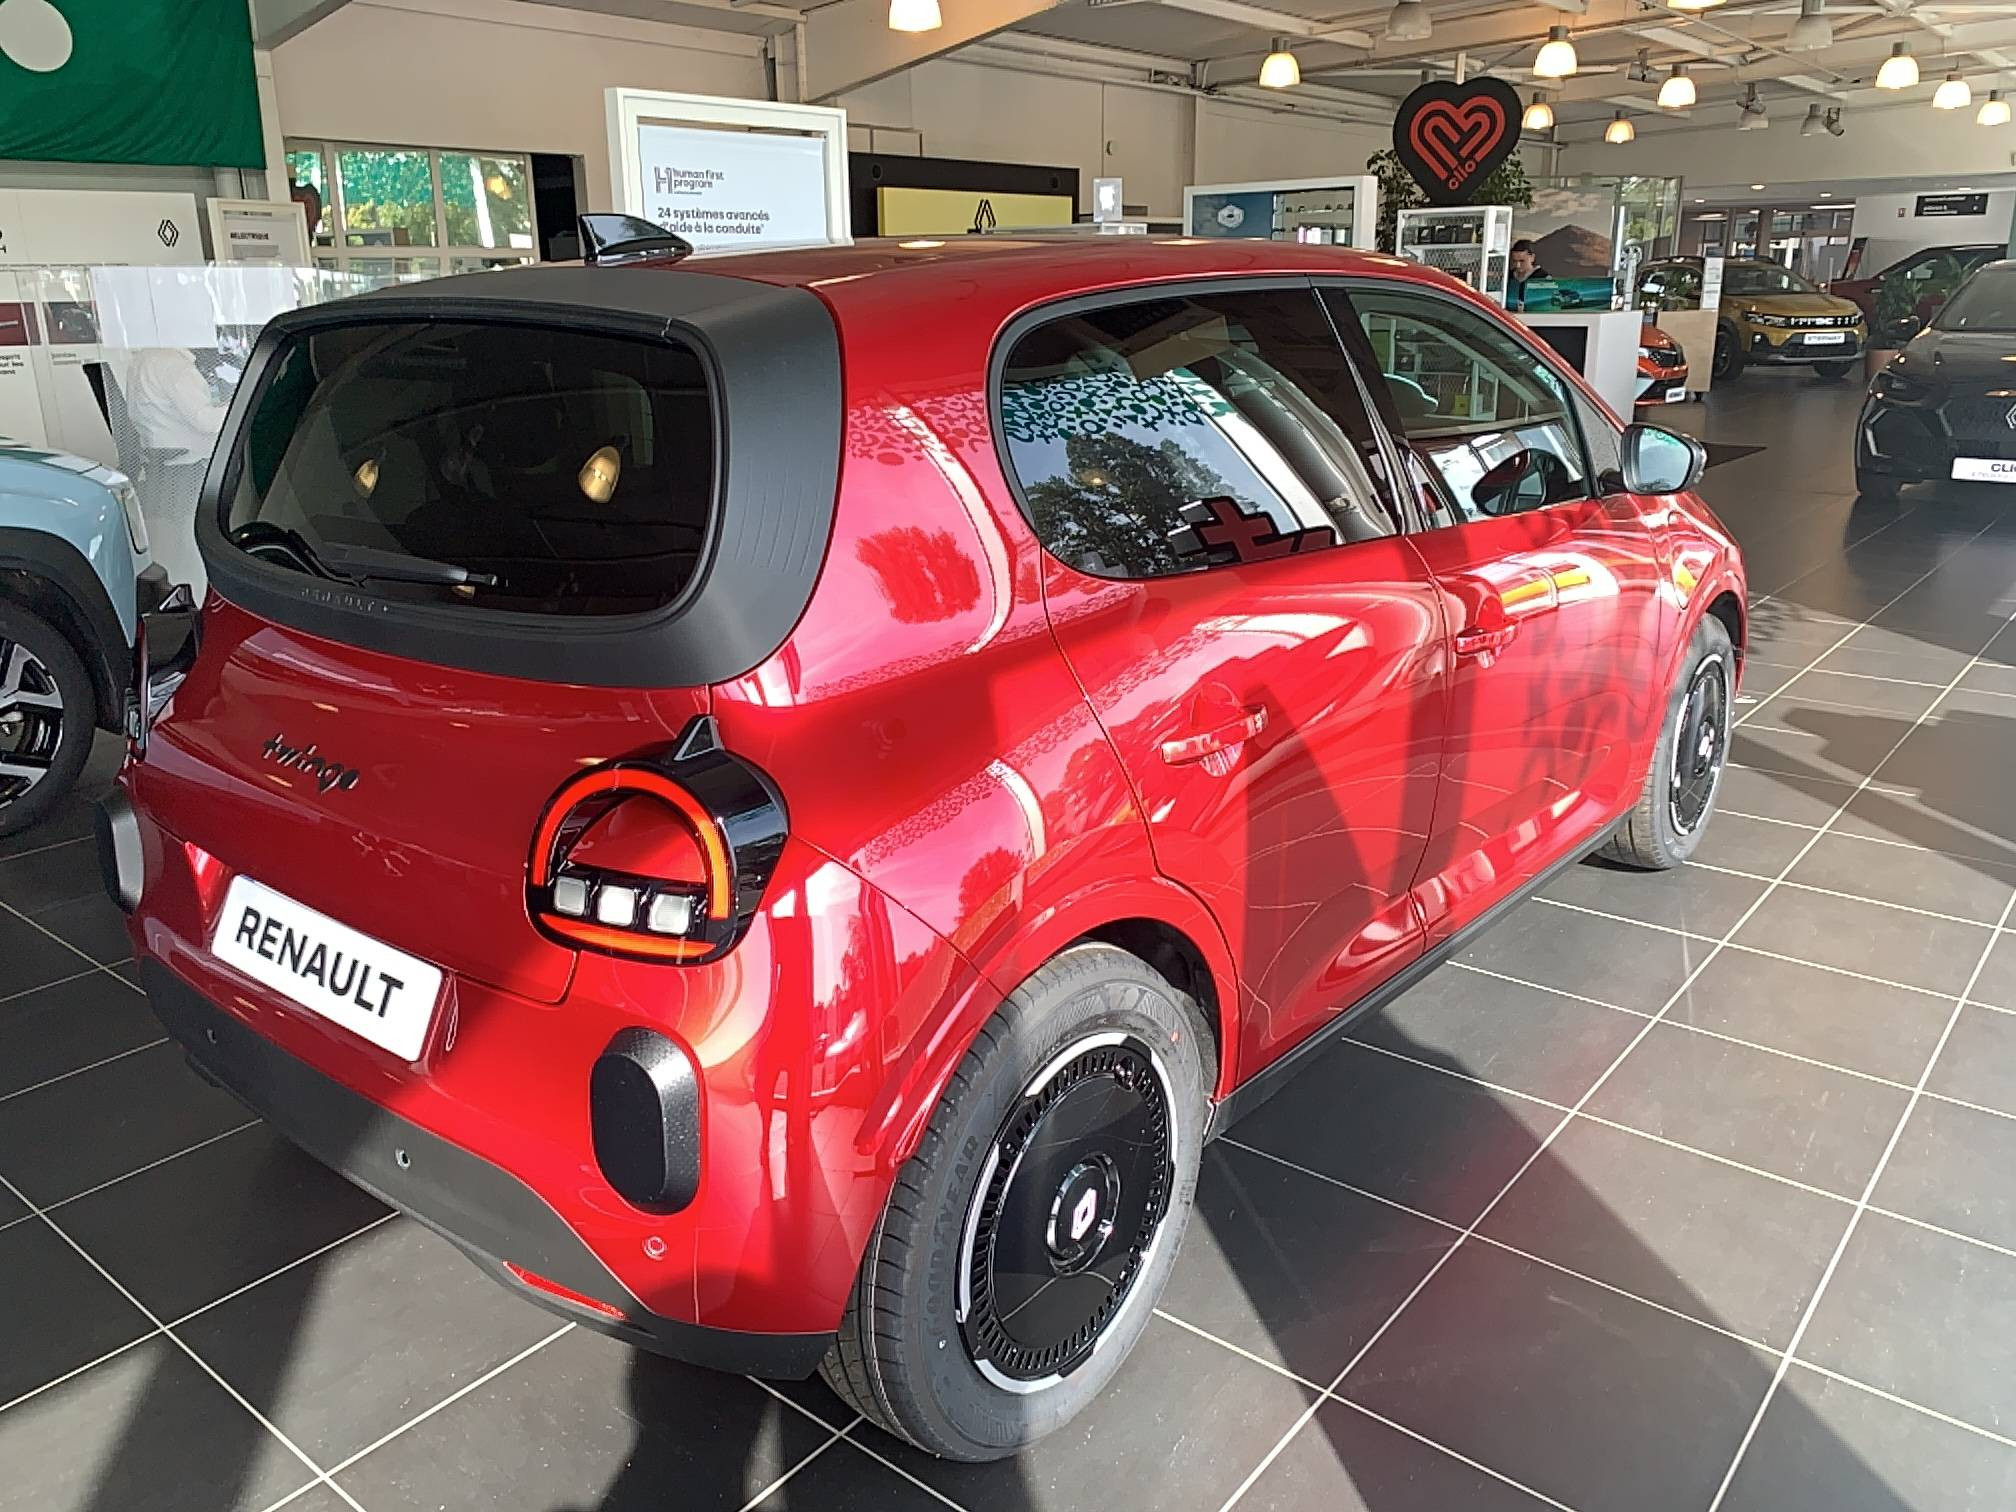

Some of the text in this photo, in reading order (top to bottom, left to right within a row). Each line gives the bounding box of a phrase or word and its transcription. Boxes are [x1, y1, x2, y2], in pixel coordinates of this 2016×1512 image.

[673, 168, 725, 180] human first
[1448, 160, 1477, 190] clio
[673, 179, 713, 190] program
[657, 207, 770, 221] 24 systèmes avancés
[703, 222, 714, 234] la
[263, 733, 361, 795] twingo
[234, 905, 404, 1018] RENAULT
